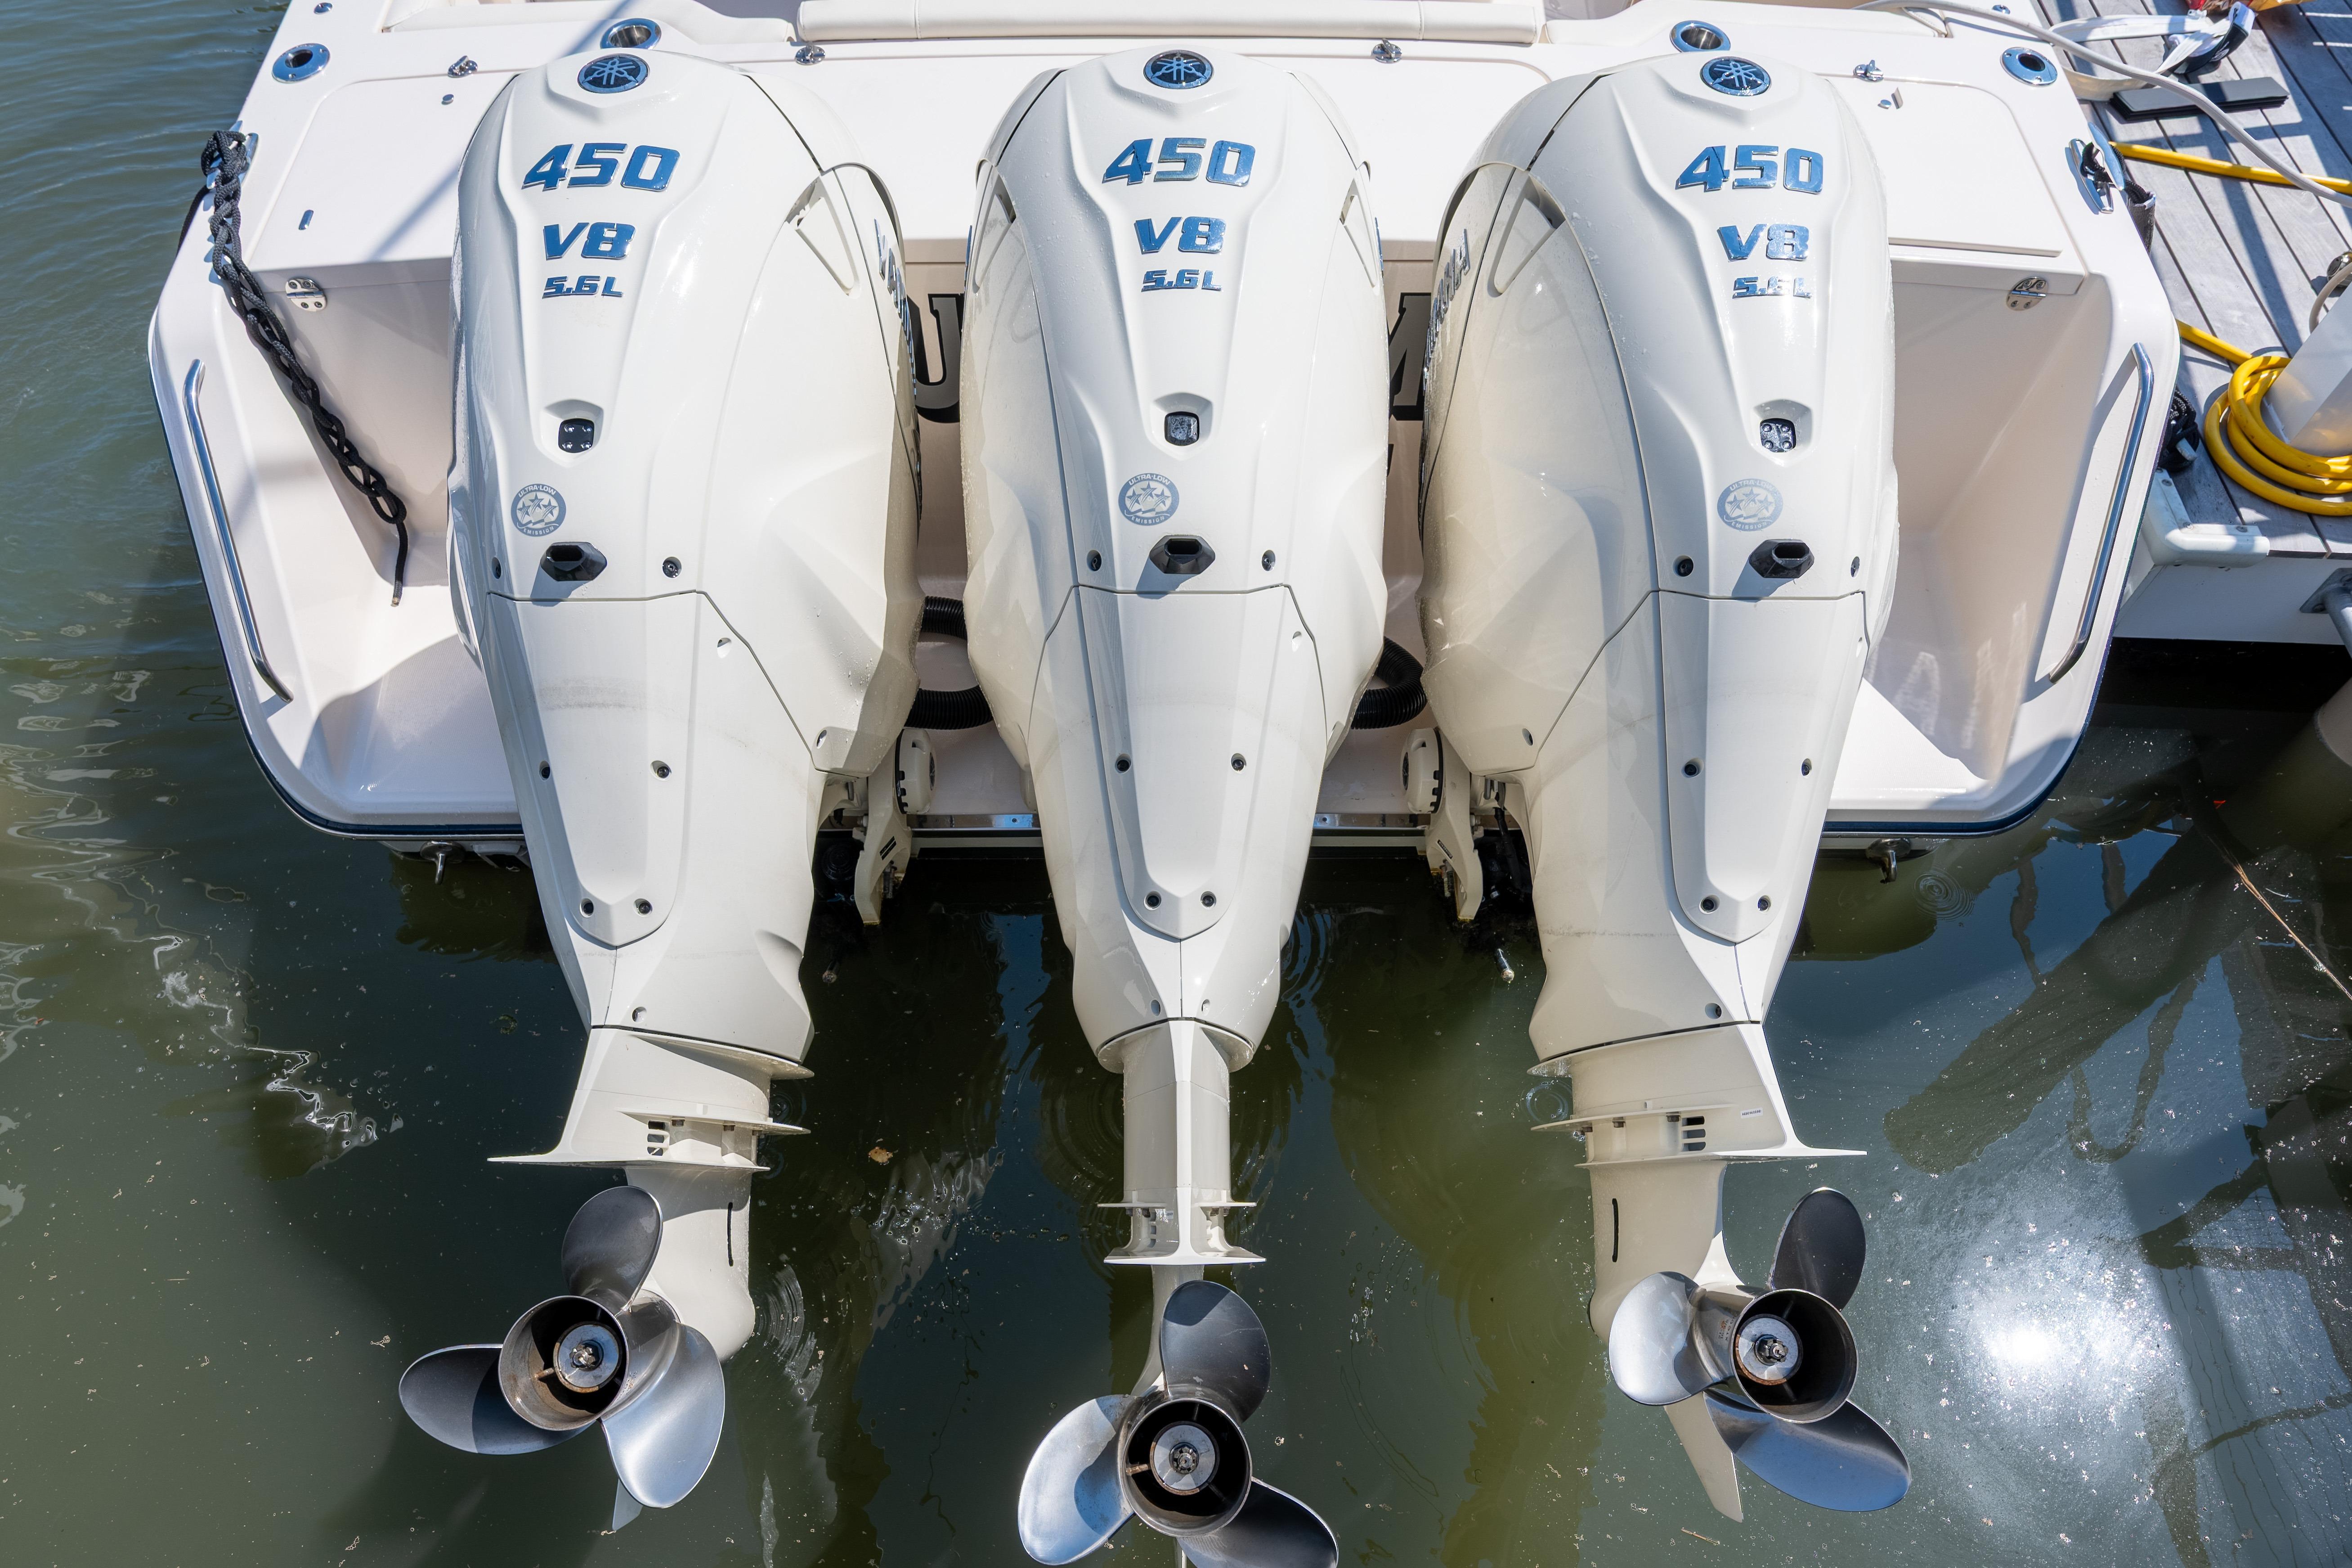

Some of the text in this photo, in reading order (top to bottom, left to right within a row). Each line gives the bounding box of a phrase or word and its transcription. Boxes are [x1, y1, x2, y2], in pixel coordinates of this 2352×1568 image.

[521, 143, 681, 192] 450
[1102, 137, 1256, 186] 450
[1675, 144, 1823, 194] 450
[543, 222, 636, 260] V8
[1133, 215, 1227, 255] V8
[1717, 223, 1810, 262] V8
[542, 275, 624, 299] 5.6L
[1141, 268, 1224, 292] 5.6L
[1732, 276, 1813, 299] 5.6L
[524, 526, 554, 535] EMISSION
[1131, 515, 1165, 524] EMISSION
